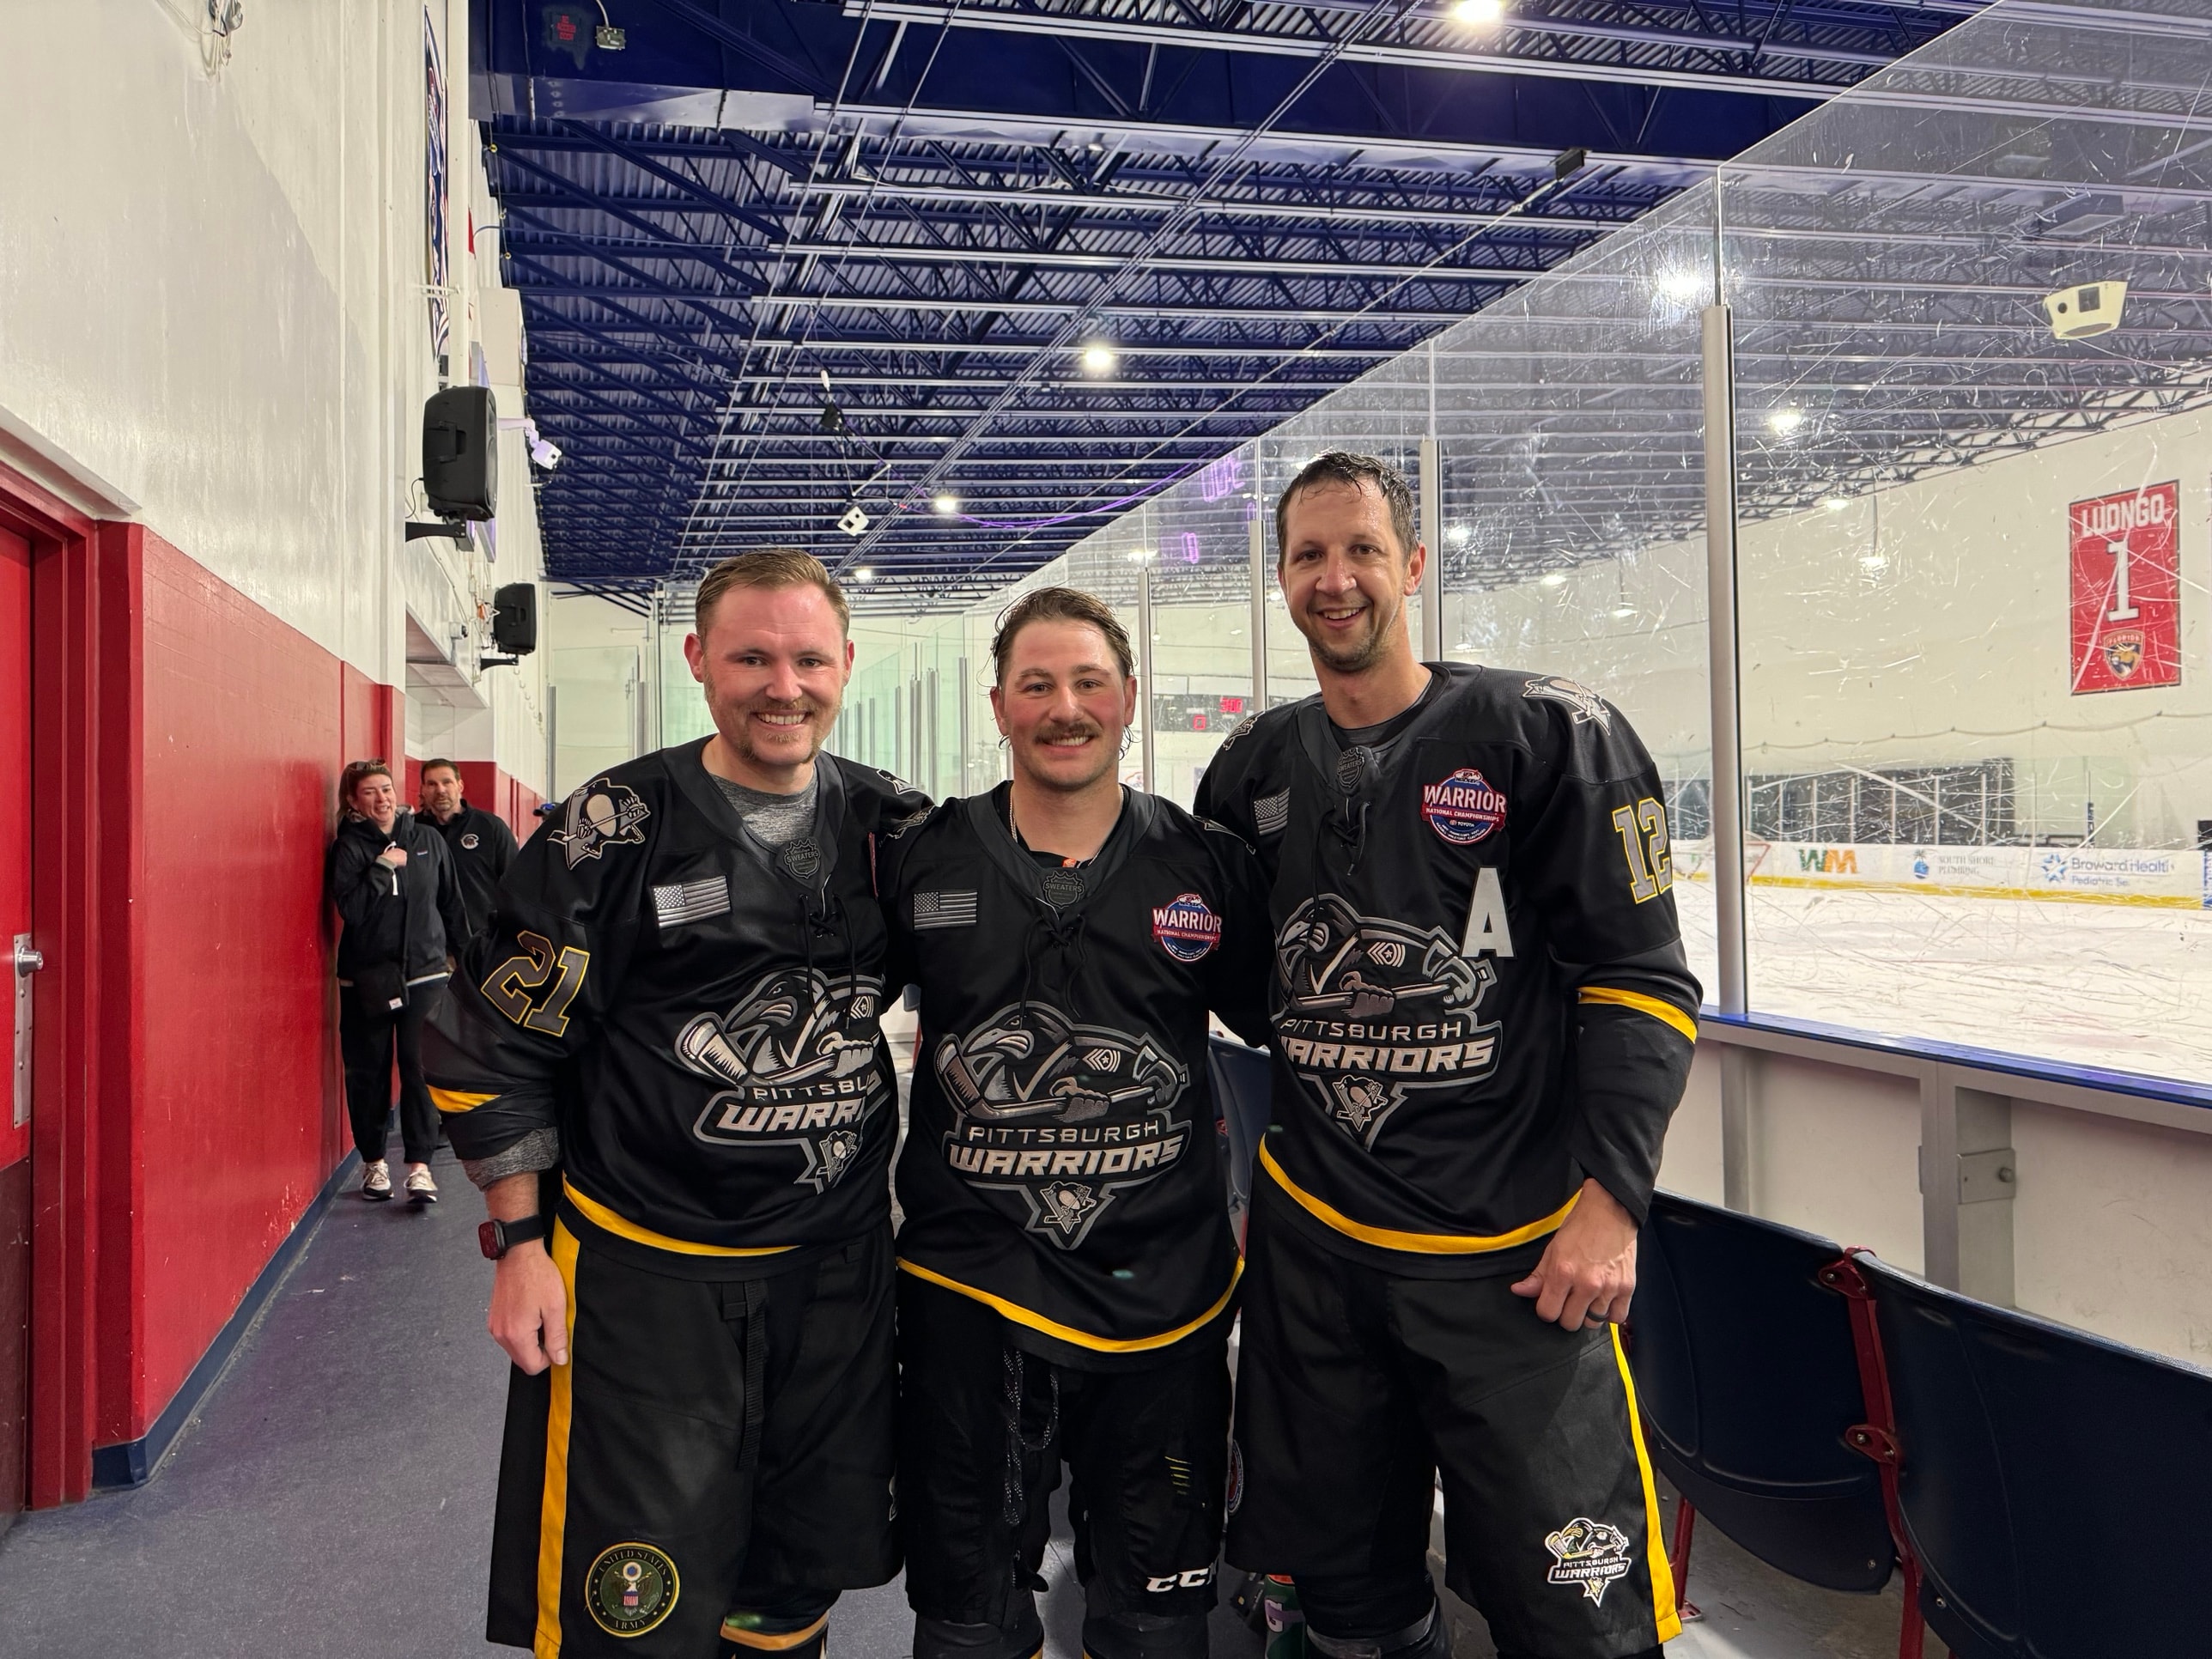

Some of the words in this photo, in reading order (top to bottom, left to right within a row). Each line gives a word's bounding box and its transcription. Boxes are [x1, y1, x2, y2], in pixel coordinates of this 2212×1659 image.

[2081, 493, 2165, 538] LUONGO
[2107, 539, 2140, 623] 1
[1424, 785, 1506, 813] WARRIOR
[1454, 811, 1500, 822] CHAMPIONSHIPS
[786, 850, 819, 863] SWEATERS
[1612, 797, 1674, 905] 12
[1798, 848, 1857, 874] WM
[2071, 858, 2127, 871] Broward
[1044, 883, 1082, 893] SWEATERS
[1152, 908, 1223, 933] WARRIOR
[1462, 866, 1516, 958] A
[480, 930, 591, 1037] 21
[1280, 1018, 1462, 1042] PITTSBURGH
[969, 1120, 1158, 1144] PITTSBURGH
[949, 1134, 1184, 1176] WARRIORS
[599, 1549, 634, 1572] UNITED
[637, 1552, 667, 1576] STATES
[1554, 1563, 1626, 1579] WARRIORS
[615, 1620, 646, 1630] ARMY
